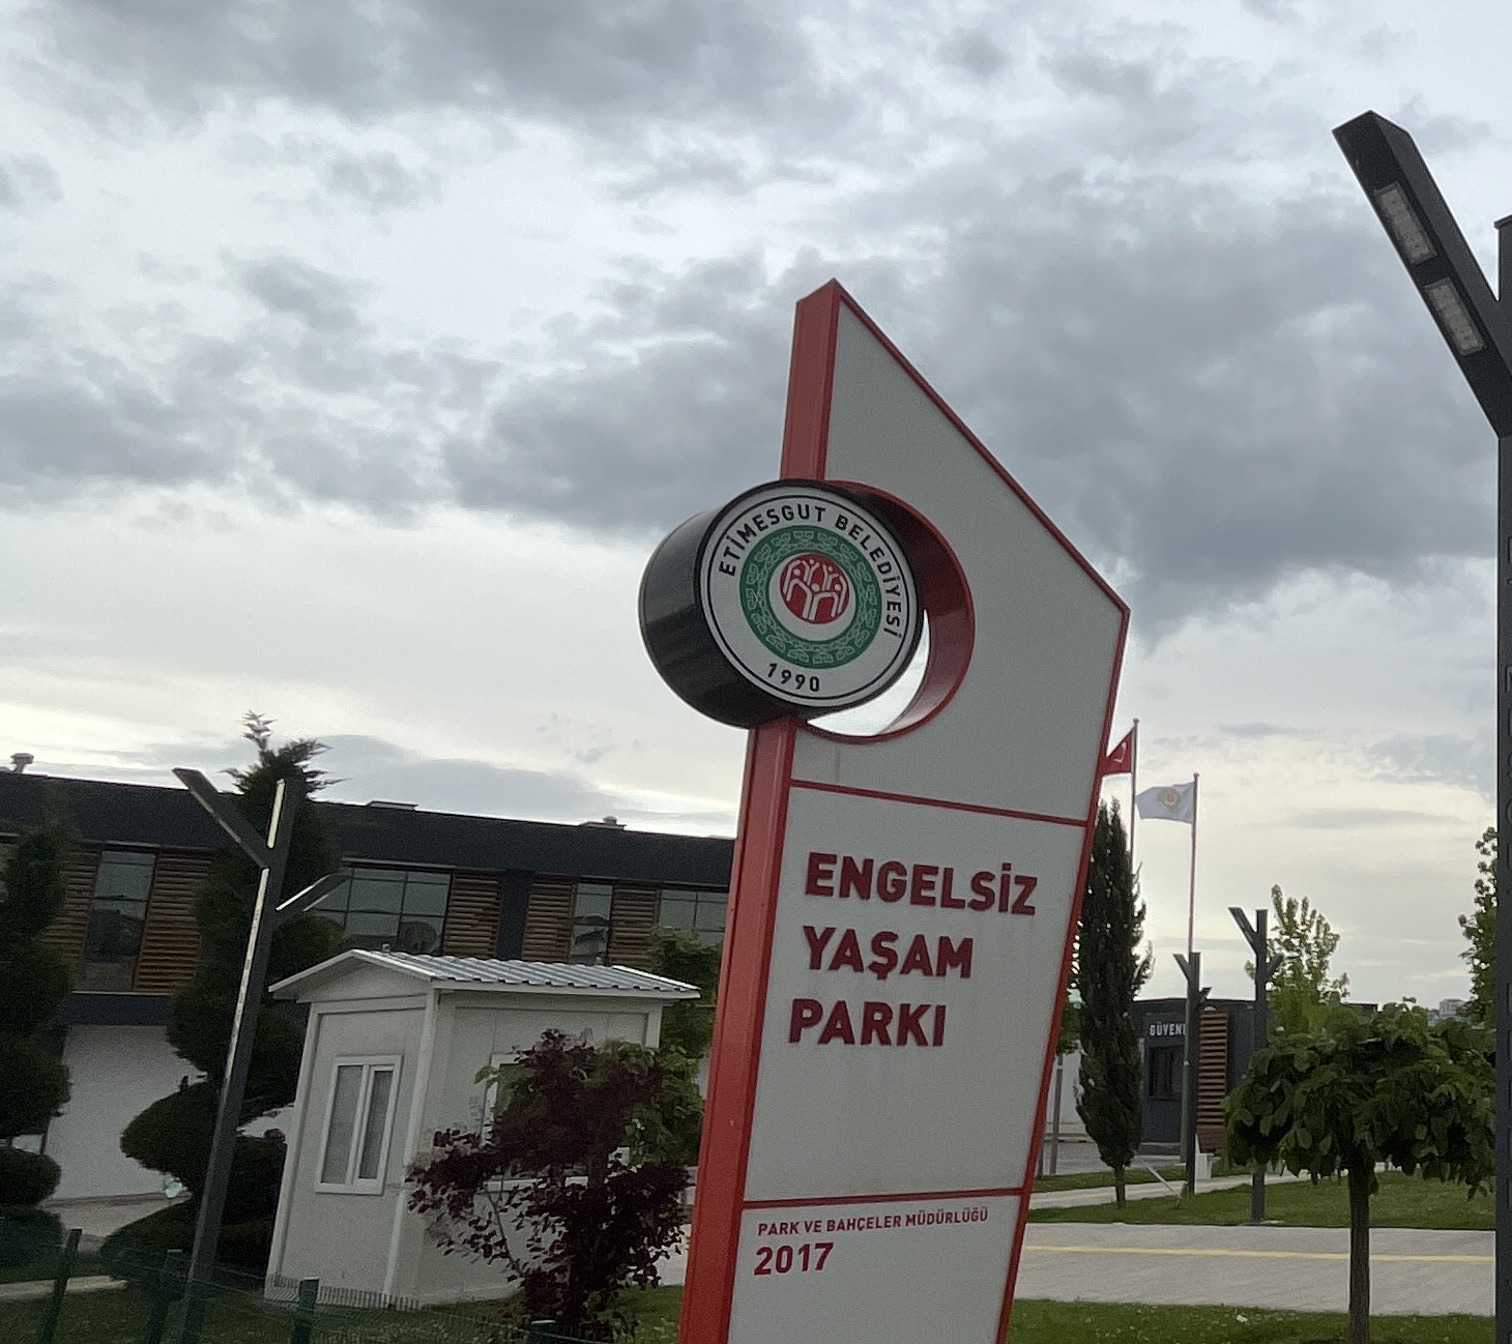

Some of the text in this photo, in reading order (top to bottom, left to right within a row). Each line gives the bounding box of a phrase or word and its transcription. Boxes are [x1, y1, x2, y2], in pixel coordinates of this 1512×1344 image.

[718, 504, 902, 639] ETİMESGUT BELEDİYESİ
[767, 662, 821, 693] 1990
[805, 852, 1038, 916] ENGELSİZ
[803, 925, 974, 980] YAŞAM
[788, 997, 947, 1047] PARKI
[757, 1206, 989, 1237] PARK VE BAHÇELER MÜDÜRLÜĞÜ
[753, 1241, 835, 1276] 2017
